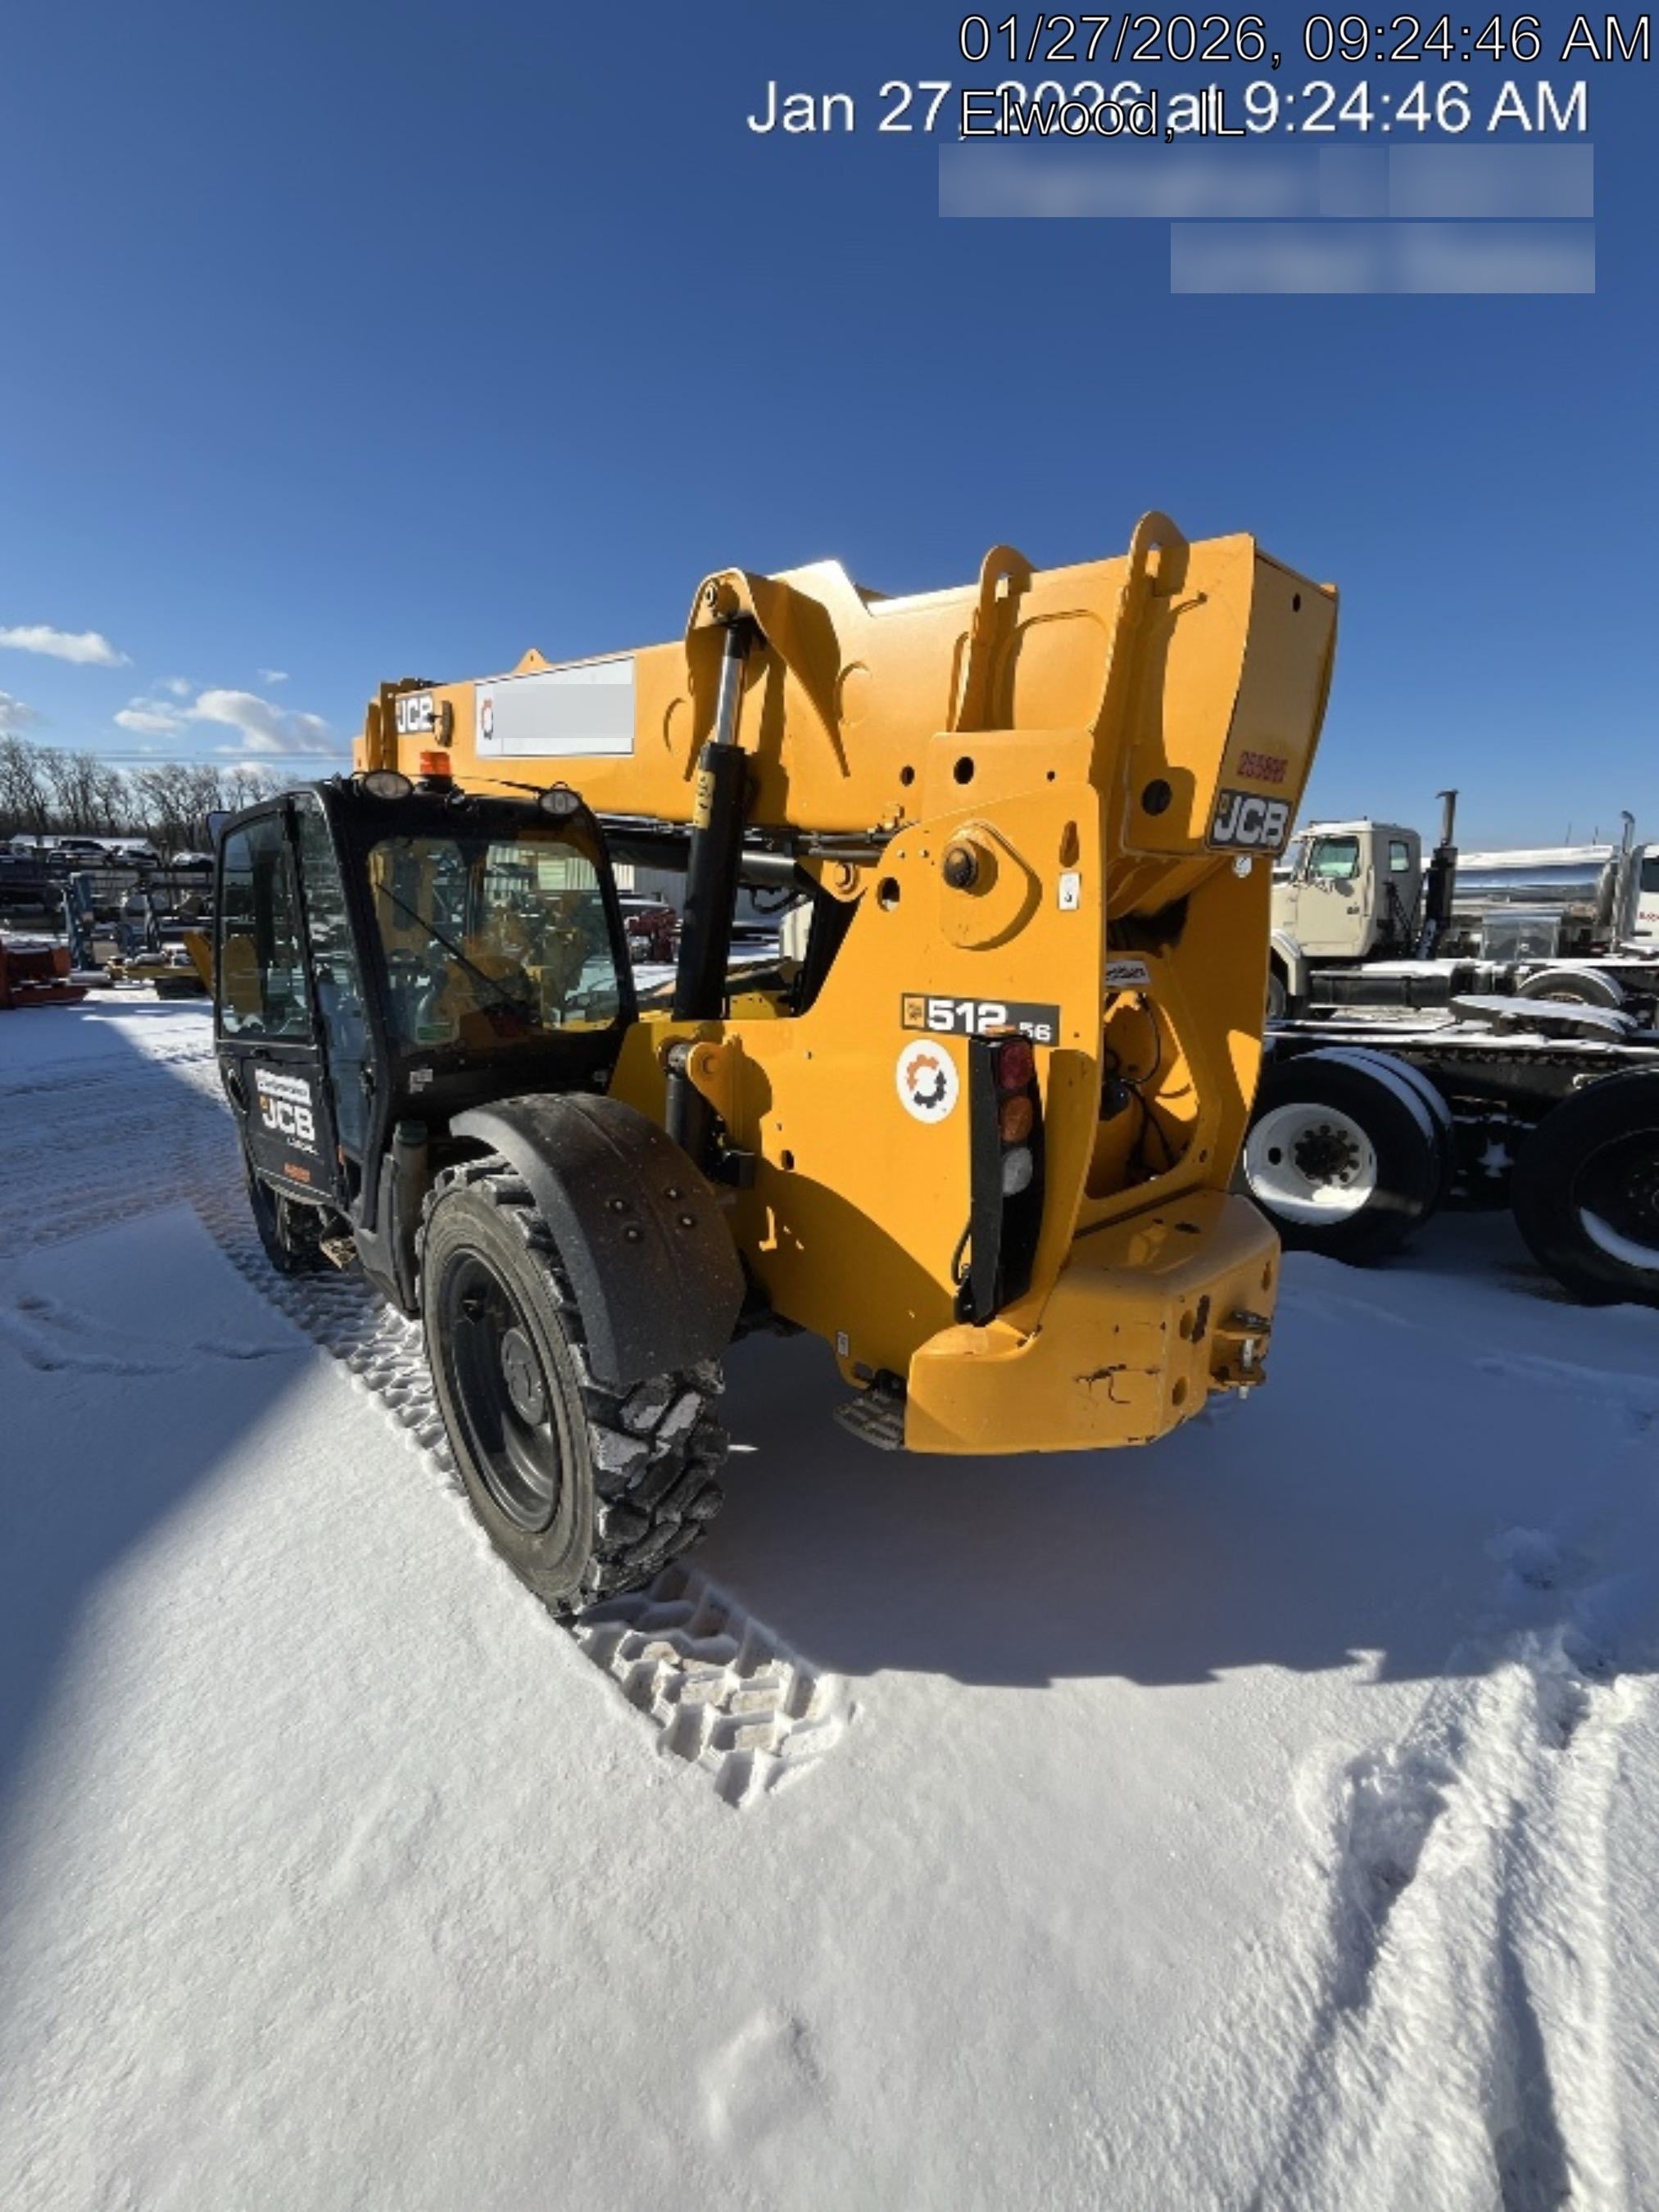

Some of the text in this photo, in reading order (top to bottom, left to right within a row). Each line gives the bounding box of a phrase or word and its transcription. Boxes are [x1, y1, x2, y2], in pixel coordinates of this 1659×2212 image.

[396, 694, 433, 734] JCB
[1213, 795, 1290, 847] JCB
[927, 998, 1009, 1035] 512
[261, 1097, 315, 1141] JCB
